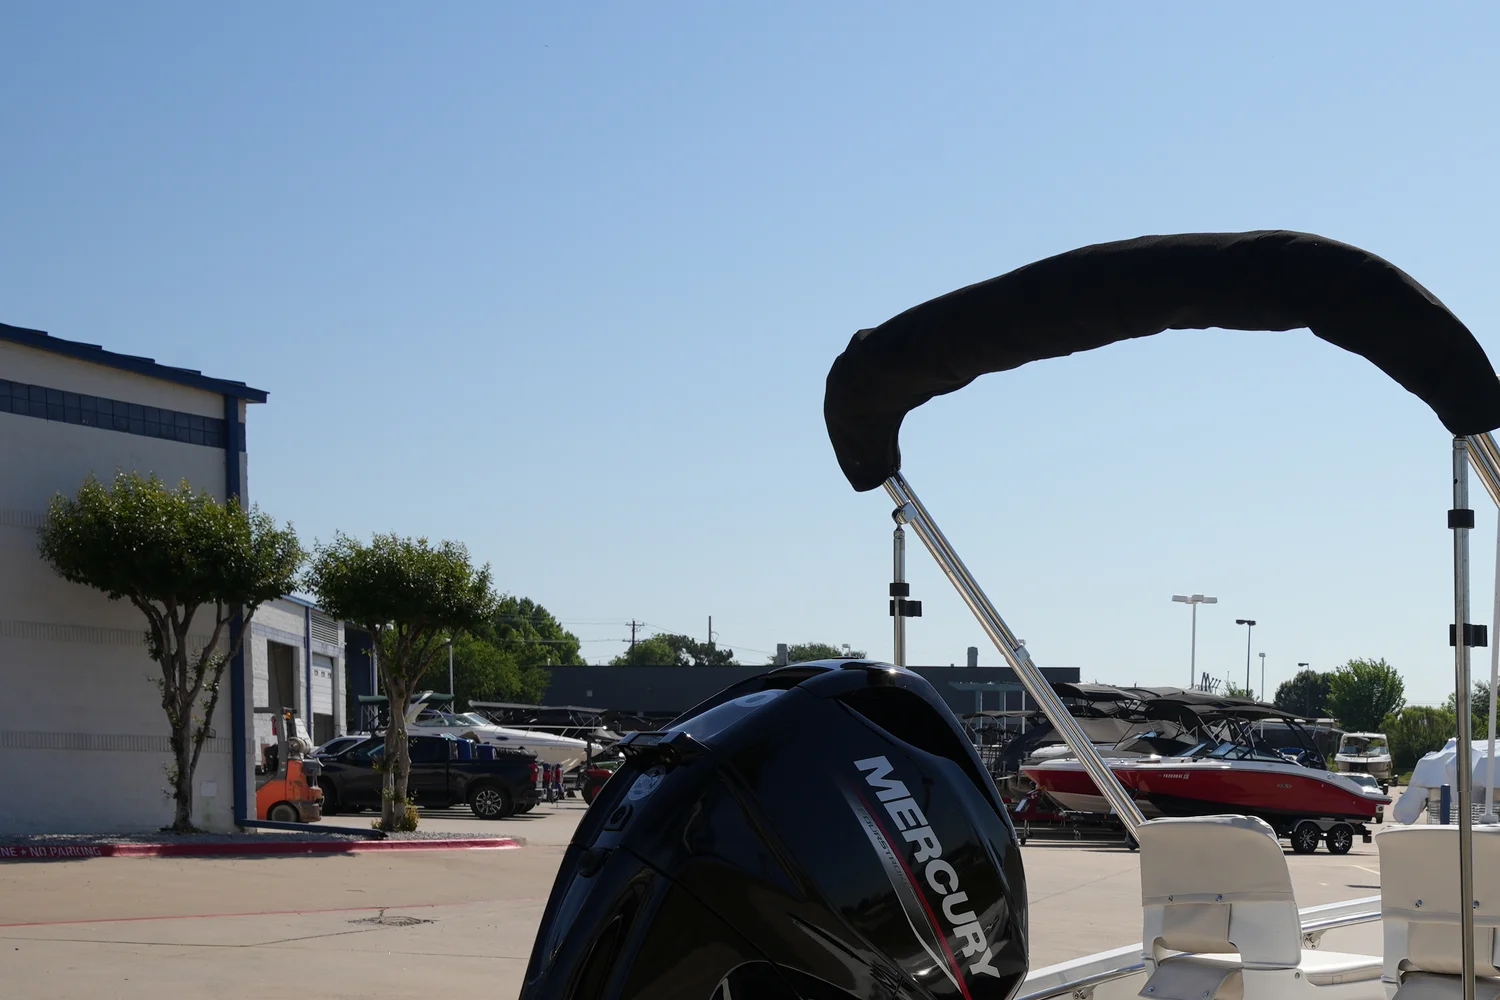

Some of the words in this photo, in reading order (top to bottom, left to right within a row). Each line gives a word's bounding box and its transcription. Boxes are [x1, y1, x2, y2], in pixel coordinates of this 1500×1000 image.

[0, 847, 18, 857] NE
[29, 846, 47, 857] NO
[49, 846, 102, 857] PARKING
[853, 755, 1001, 979] MERCURY
[857, 807, 912, 888] FOURSTROKE
